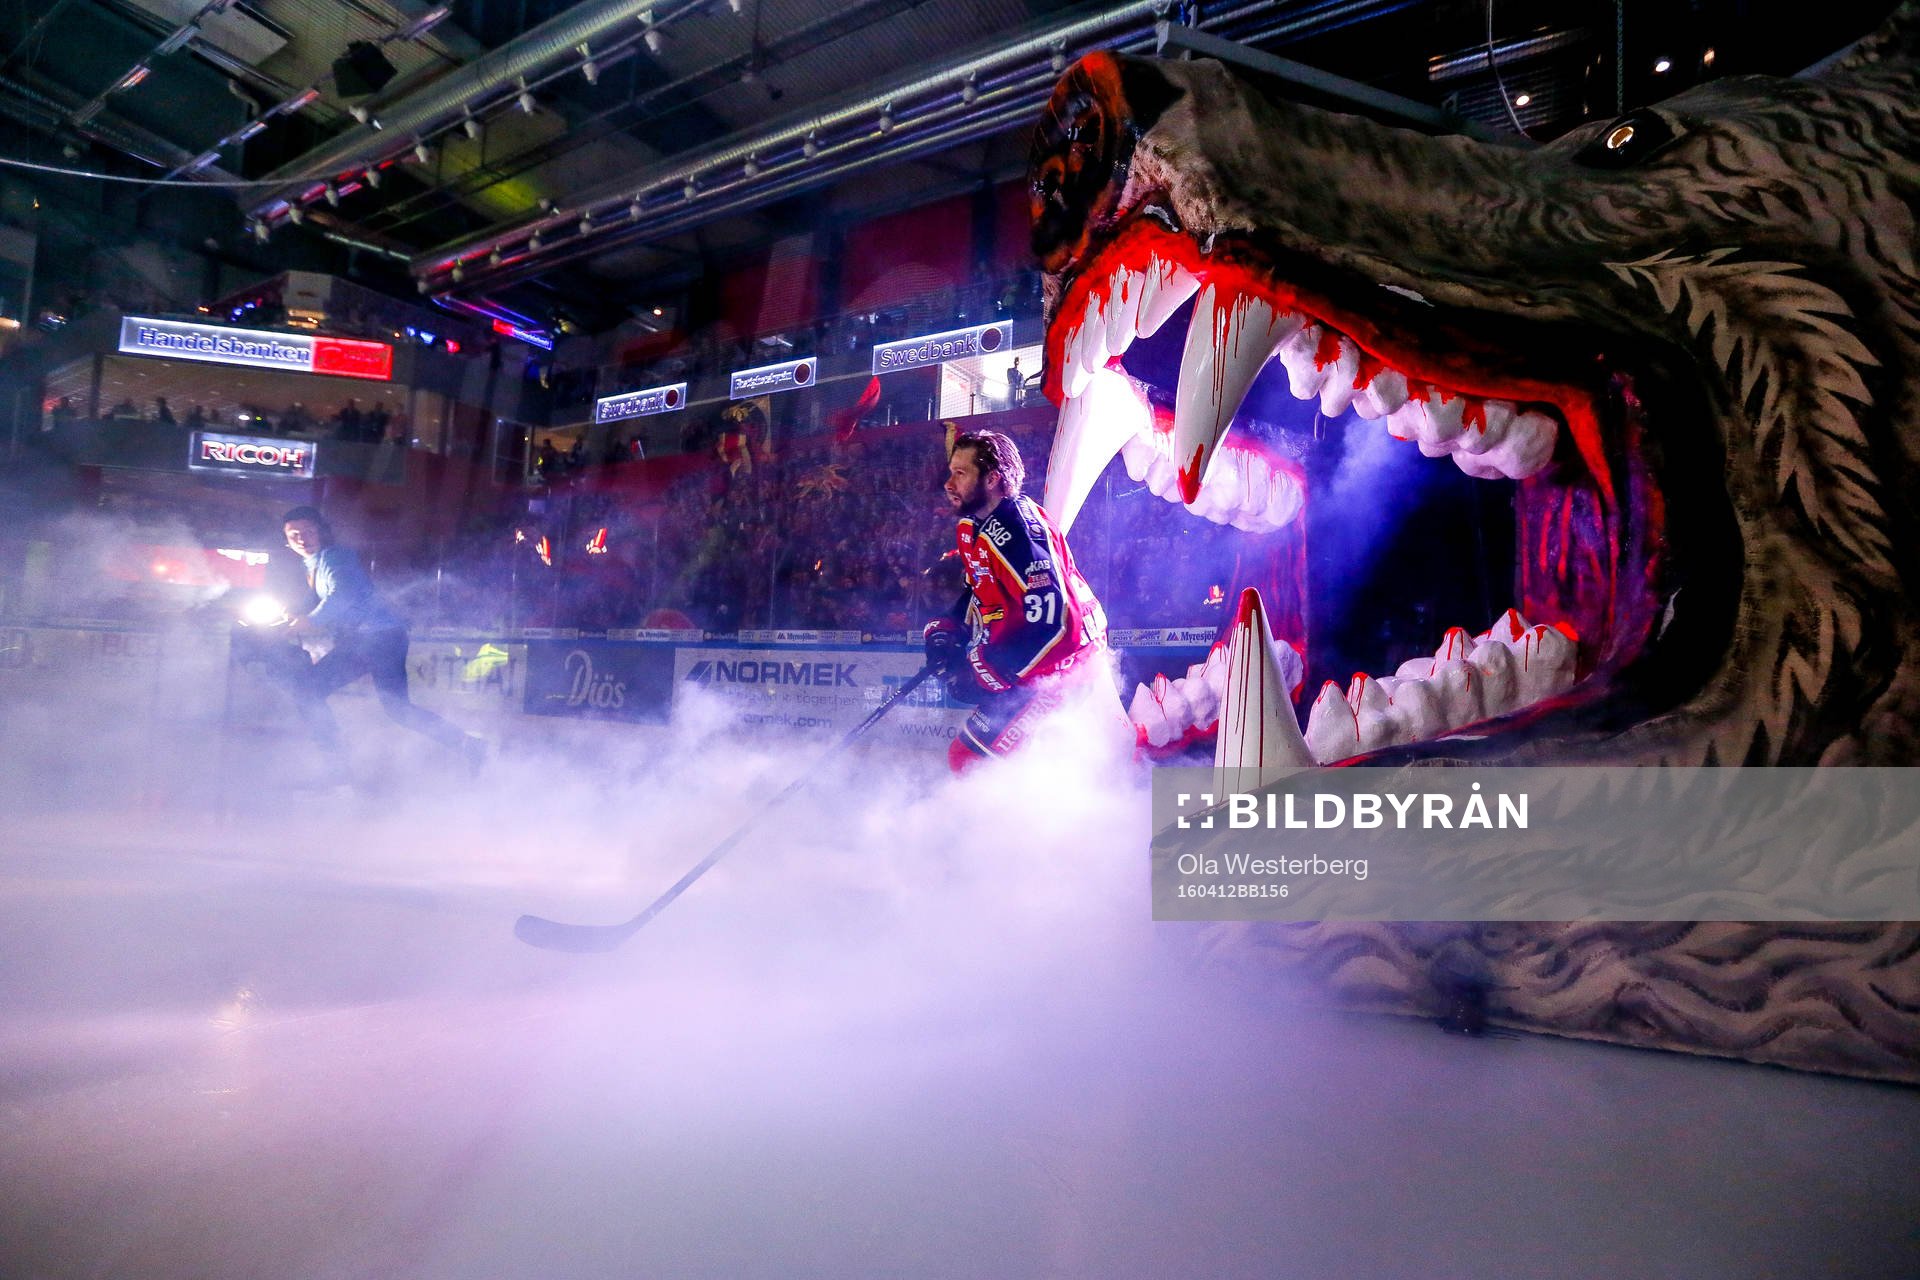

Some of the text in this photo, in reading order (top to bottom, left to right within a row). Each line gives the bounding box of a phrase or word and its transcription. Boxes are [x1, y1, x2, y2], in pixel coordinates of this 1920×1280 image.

[137, 327, 311, 364] Handelsbanken
[880, 334, 977, 368] Swedbank
[201, 440, 305, 468] RICOH
[985, 518, 1012, 547] SSAB
[1024, 592, 1056, 625] 31
[564, 649, 626, 708] Diös
[715, 660, 859, 687] NORMEK
